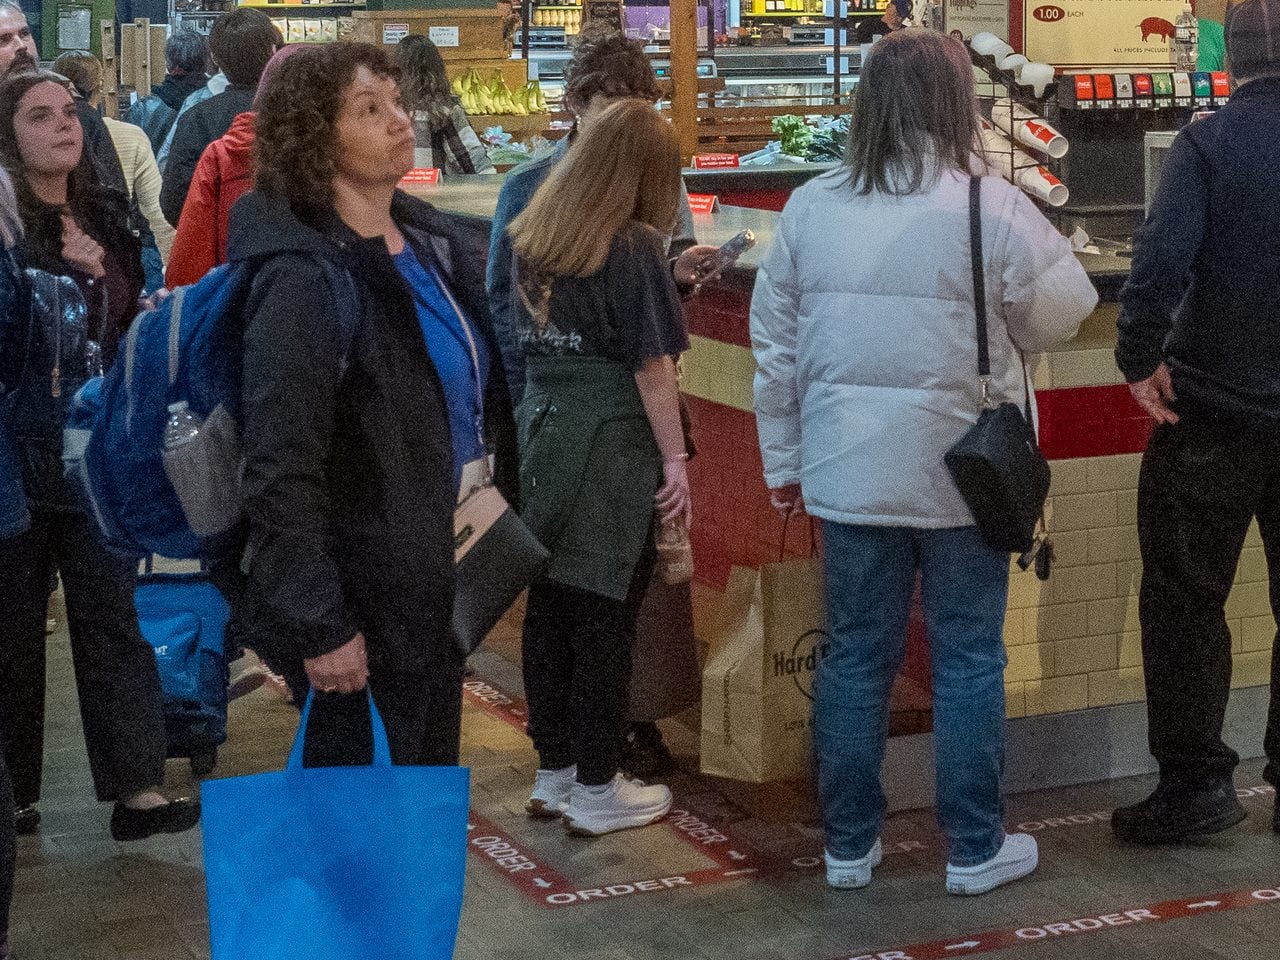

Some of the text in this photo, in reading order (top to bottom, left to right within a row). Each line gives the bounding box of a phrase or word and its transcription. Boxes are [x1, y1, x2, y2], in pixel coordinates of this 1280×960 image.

[1040, 8, 1059, 19] 1.00
[773, 647, 816, 676] Hard
[670, 809, 728, 845] ORDER
[472, 836, 536, 873] ORDER
[546, 875, 692, 905] ORDER
[1015, 907, 1160, 940] ORDER
